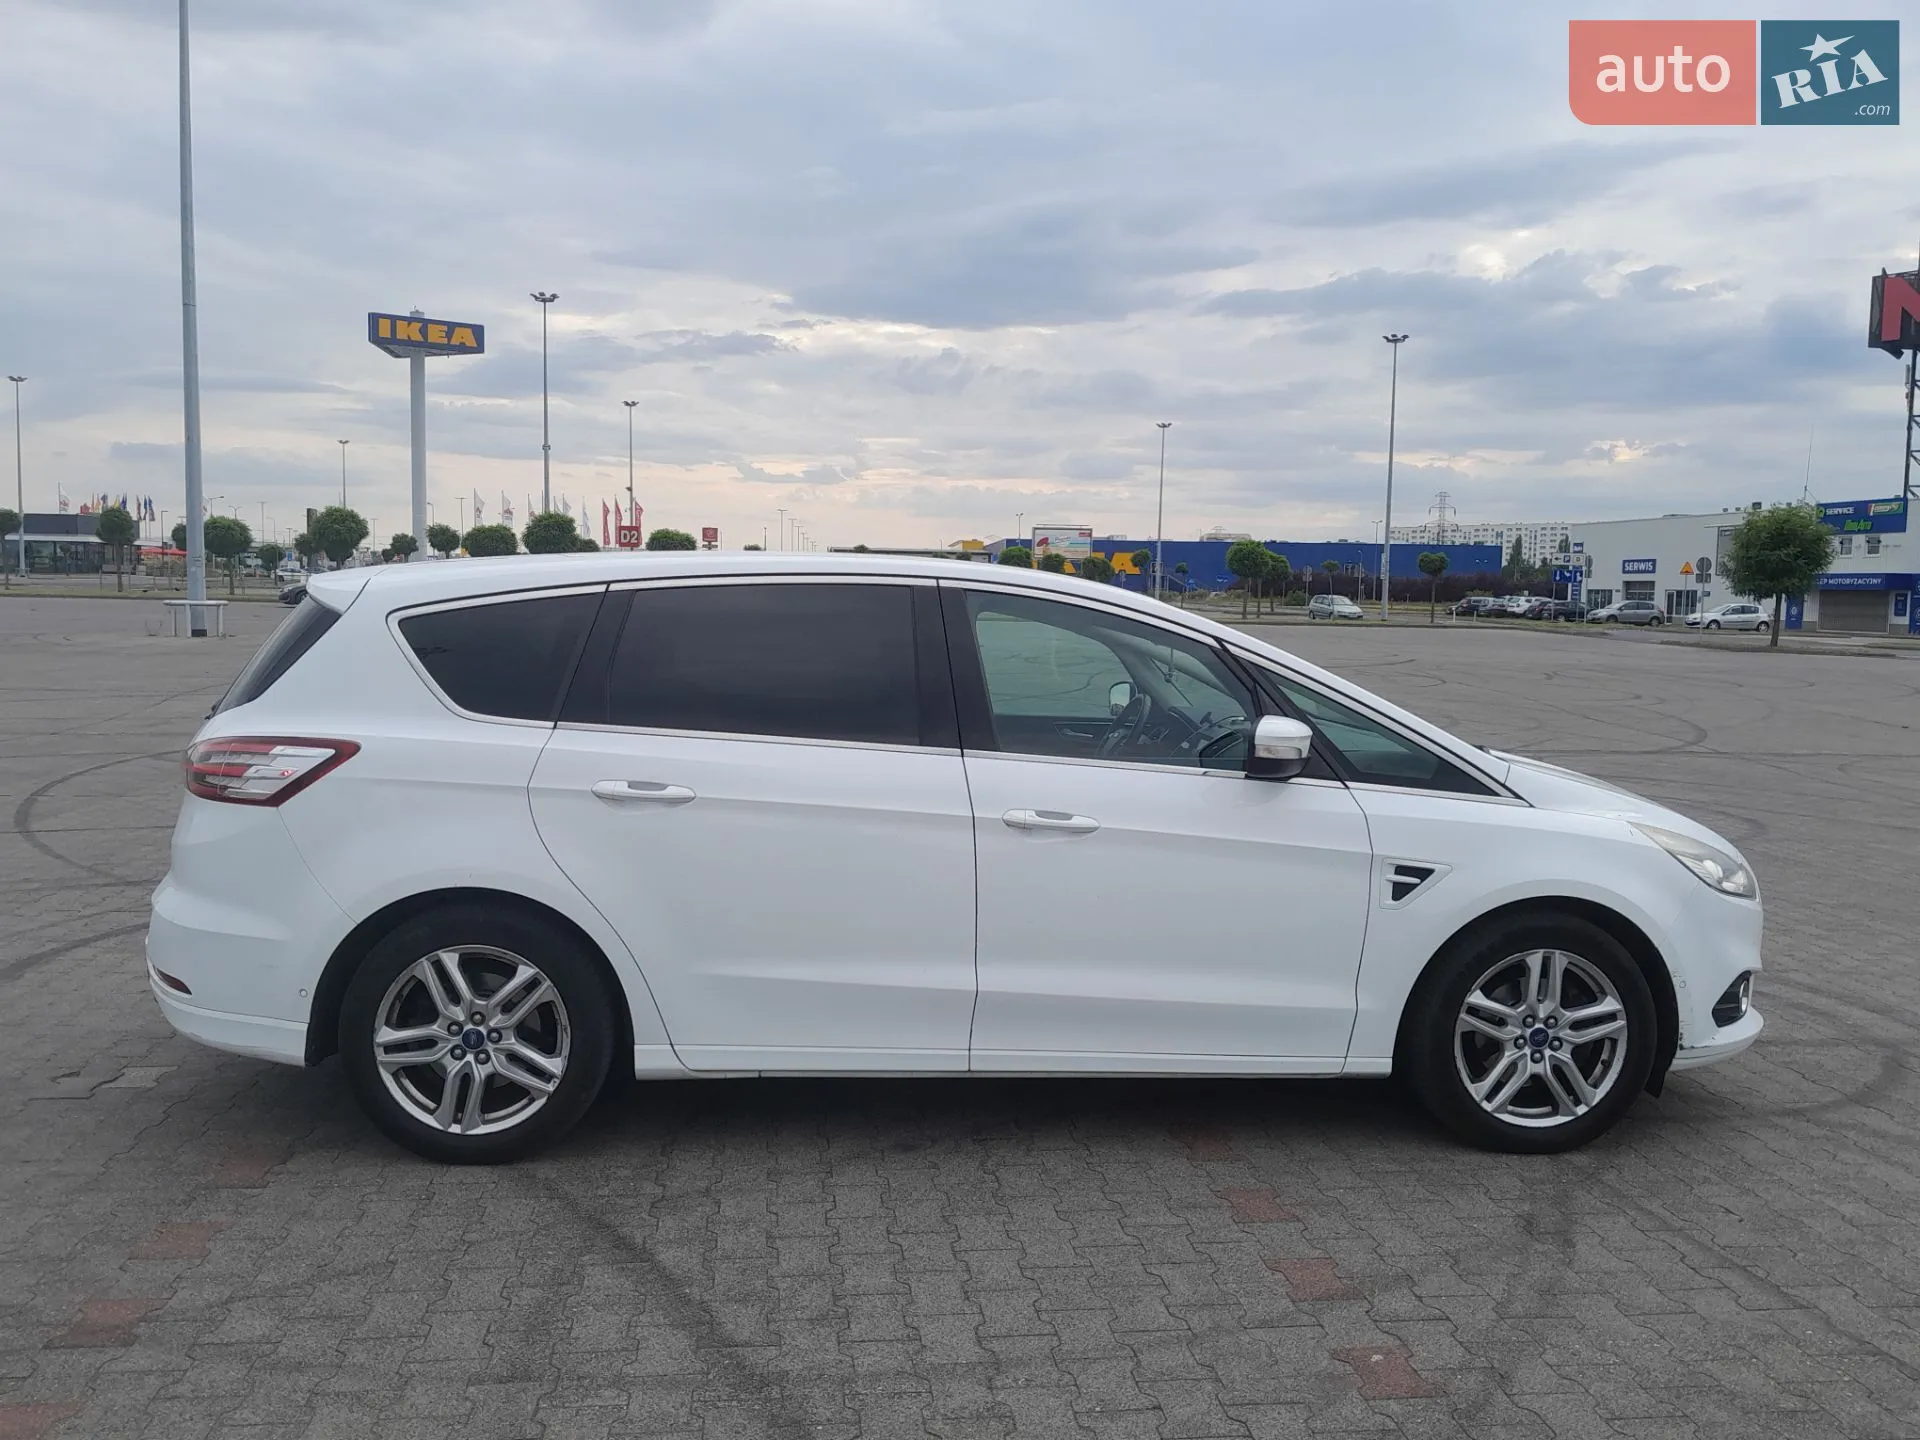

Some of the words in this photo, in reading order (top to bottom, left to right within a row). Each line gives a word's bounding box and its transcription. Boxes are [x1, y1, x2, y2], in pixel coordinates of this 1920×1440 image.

[378, 318, 478, 347] IKEA
[1826, 507, 1855, 515] SERVICE
[620, 530, 638, 543] D2
[1624, 562, 1653, 571] SERWIS
